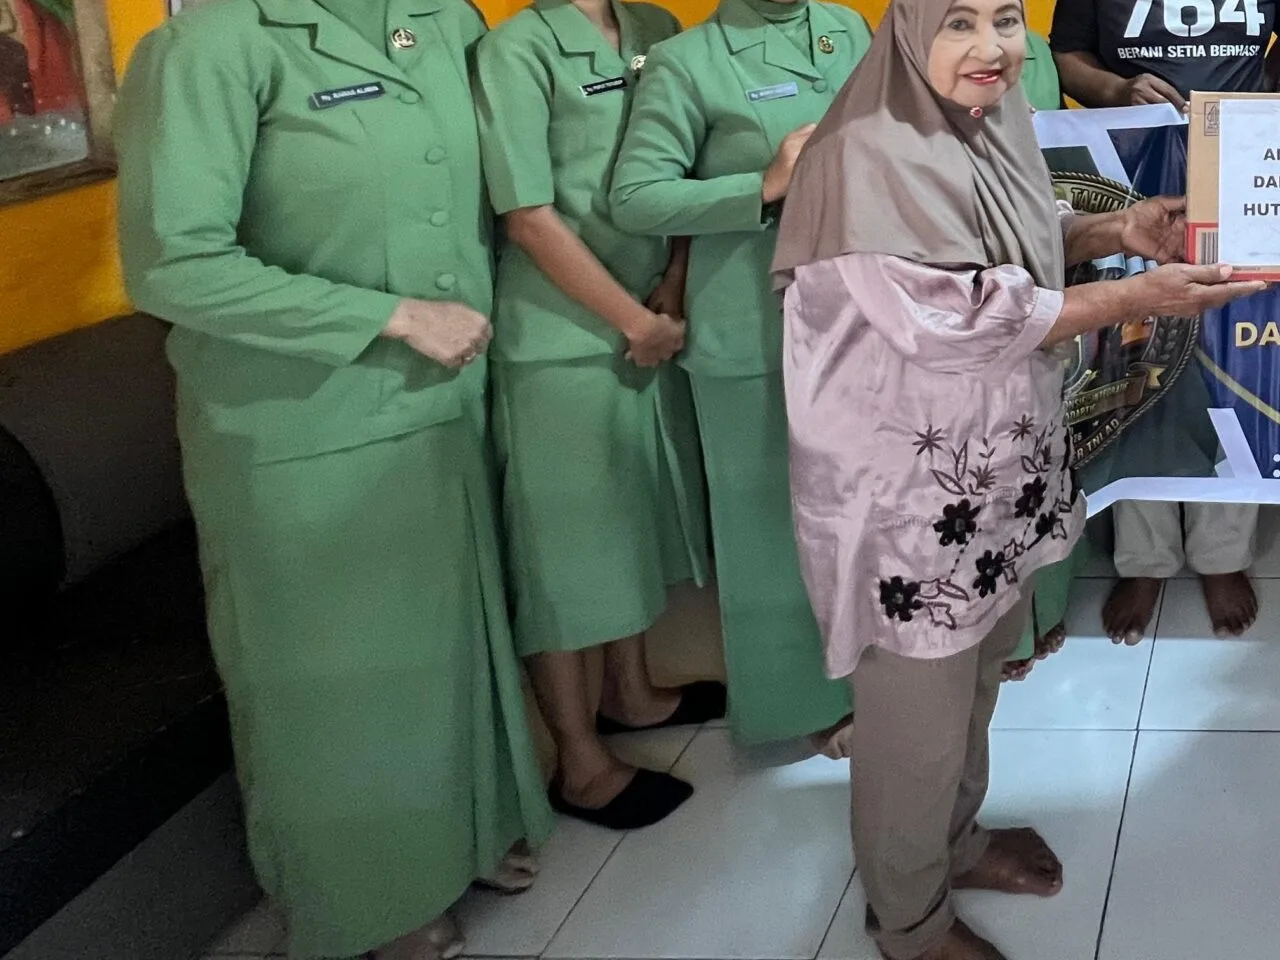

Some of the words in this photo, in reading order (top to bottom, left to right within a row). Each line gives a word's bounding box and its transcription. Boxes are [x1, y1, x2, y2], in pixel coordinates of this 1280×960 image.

[1117, 46, 1163, 59] BERANI
[1167, 44, 1206, 58] SETIA
[1243, 203, 1280, 216] HUT
